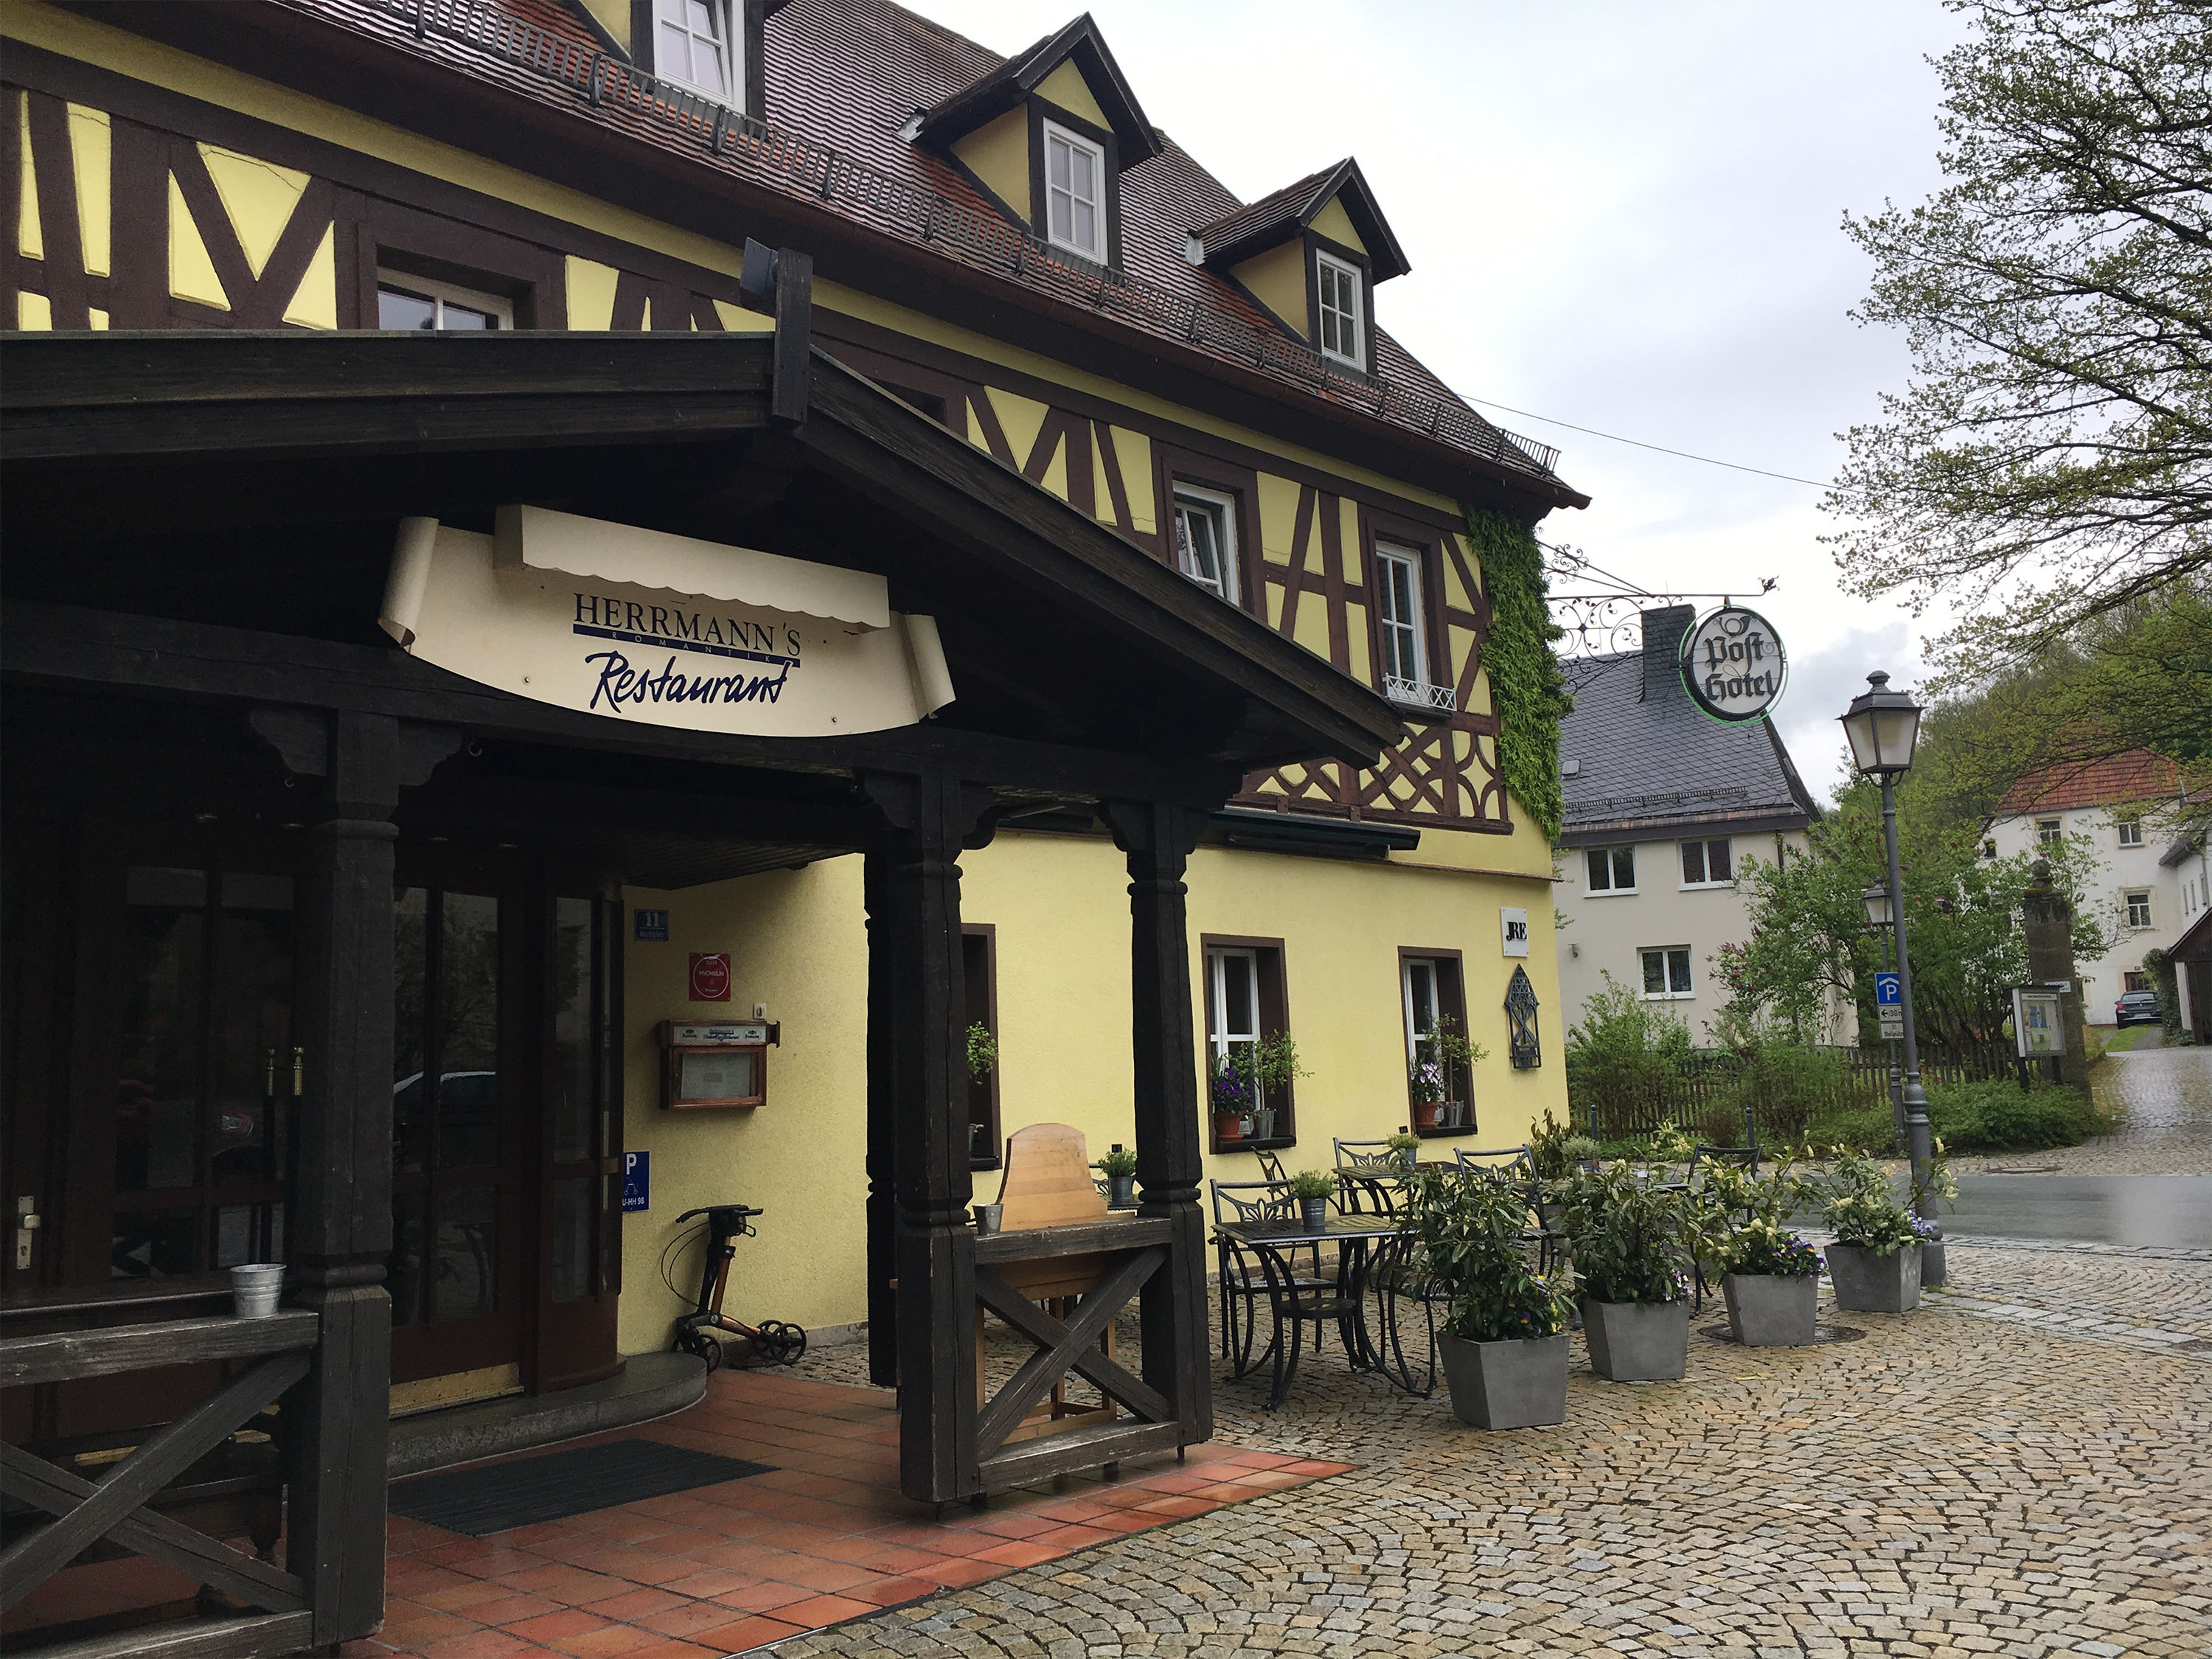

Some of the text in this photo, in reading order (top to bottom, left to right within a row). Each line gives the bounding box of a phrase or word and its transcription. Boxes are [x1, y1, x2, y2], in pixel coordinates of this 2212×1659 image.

[574, 593, 801, 656] HERRMANN'S
[612, 632, 770, 662] ROMANTIK
[585, 650, 792, 713] Restaurant
[1705, 669, 1776, 703] Hotel
[645, 912, 659, 926] 11
[1506, 921, 1528, 942] JRE
[1886, 984, 1897, 1001] P
[626, 1153, 637, 1175] P
[637, 1197, 644, 1205] 98
